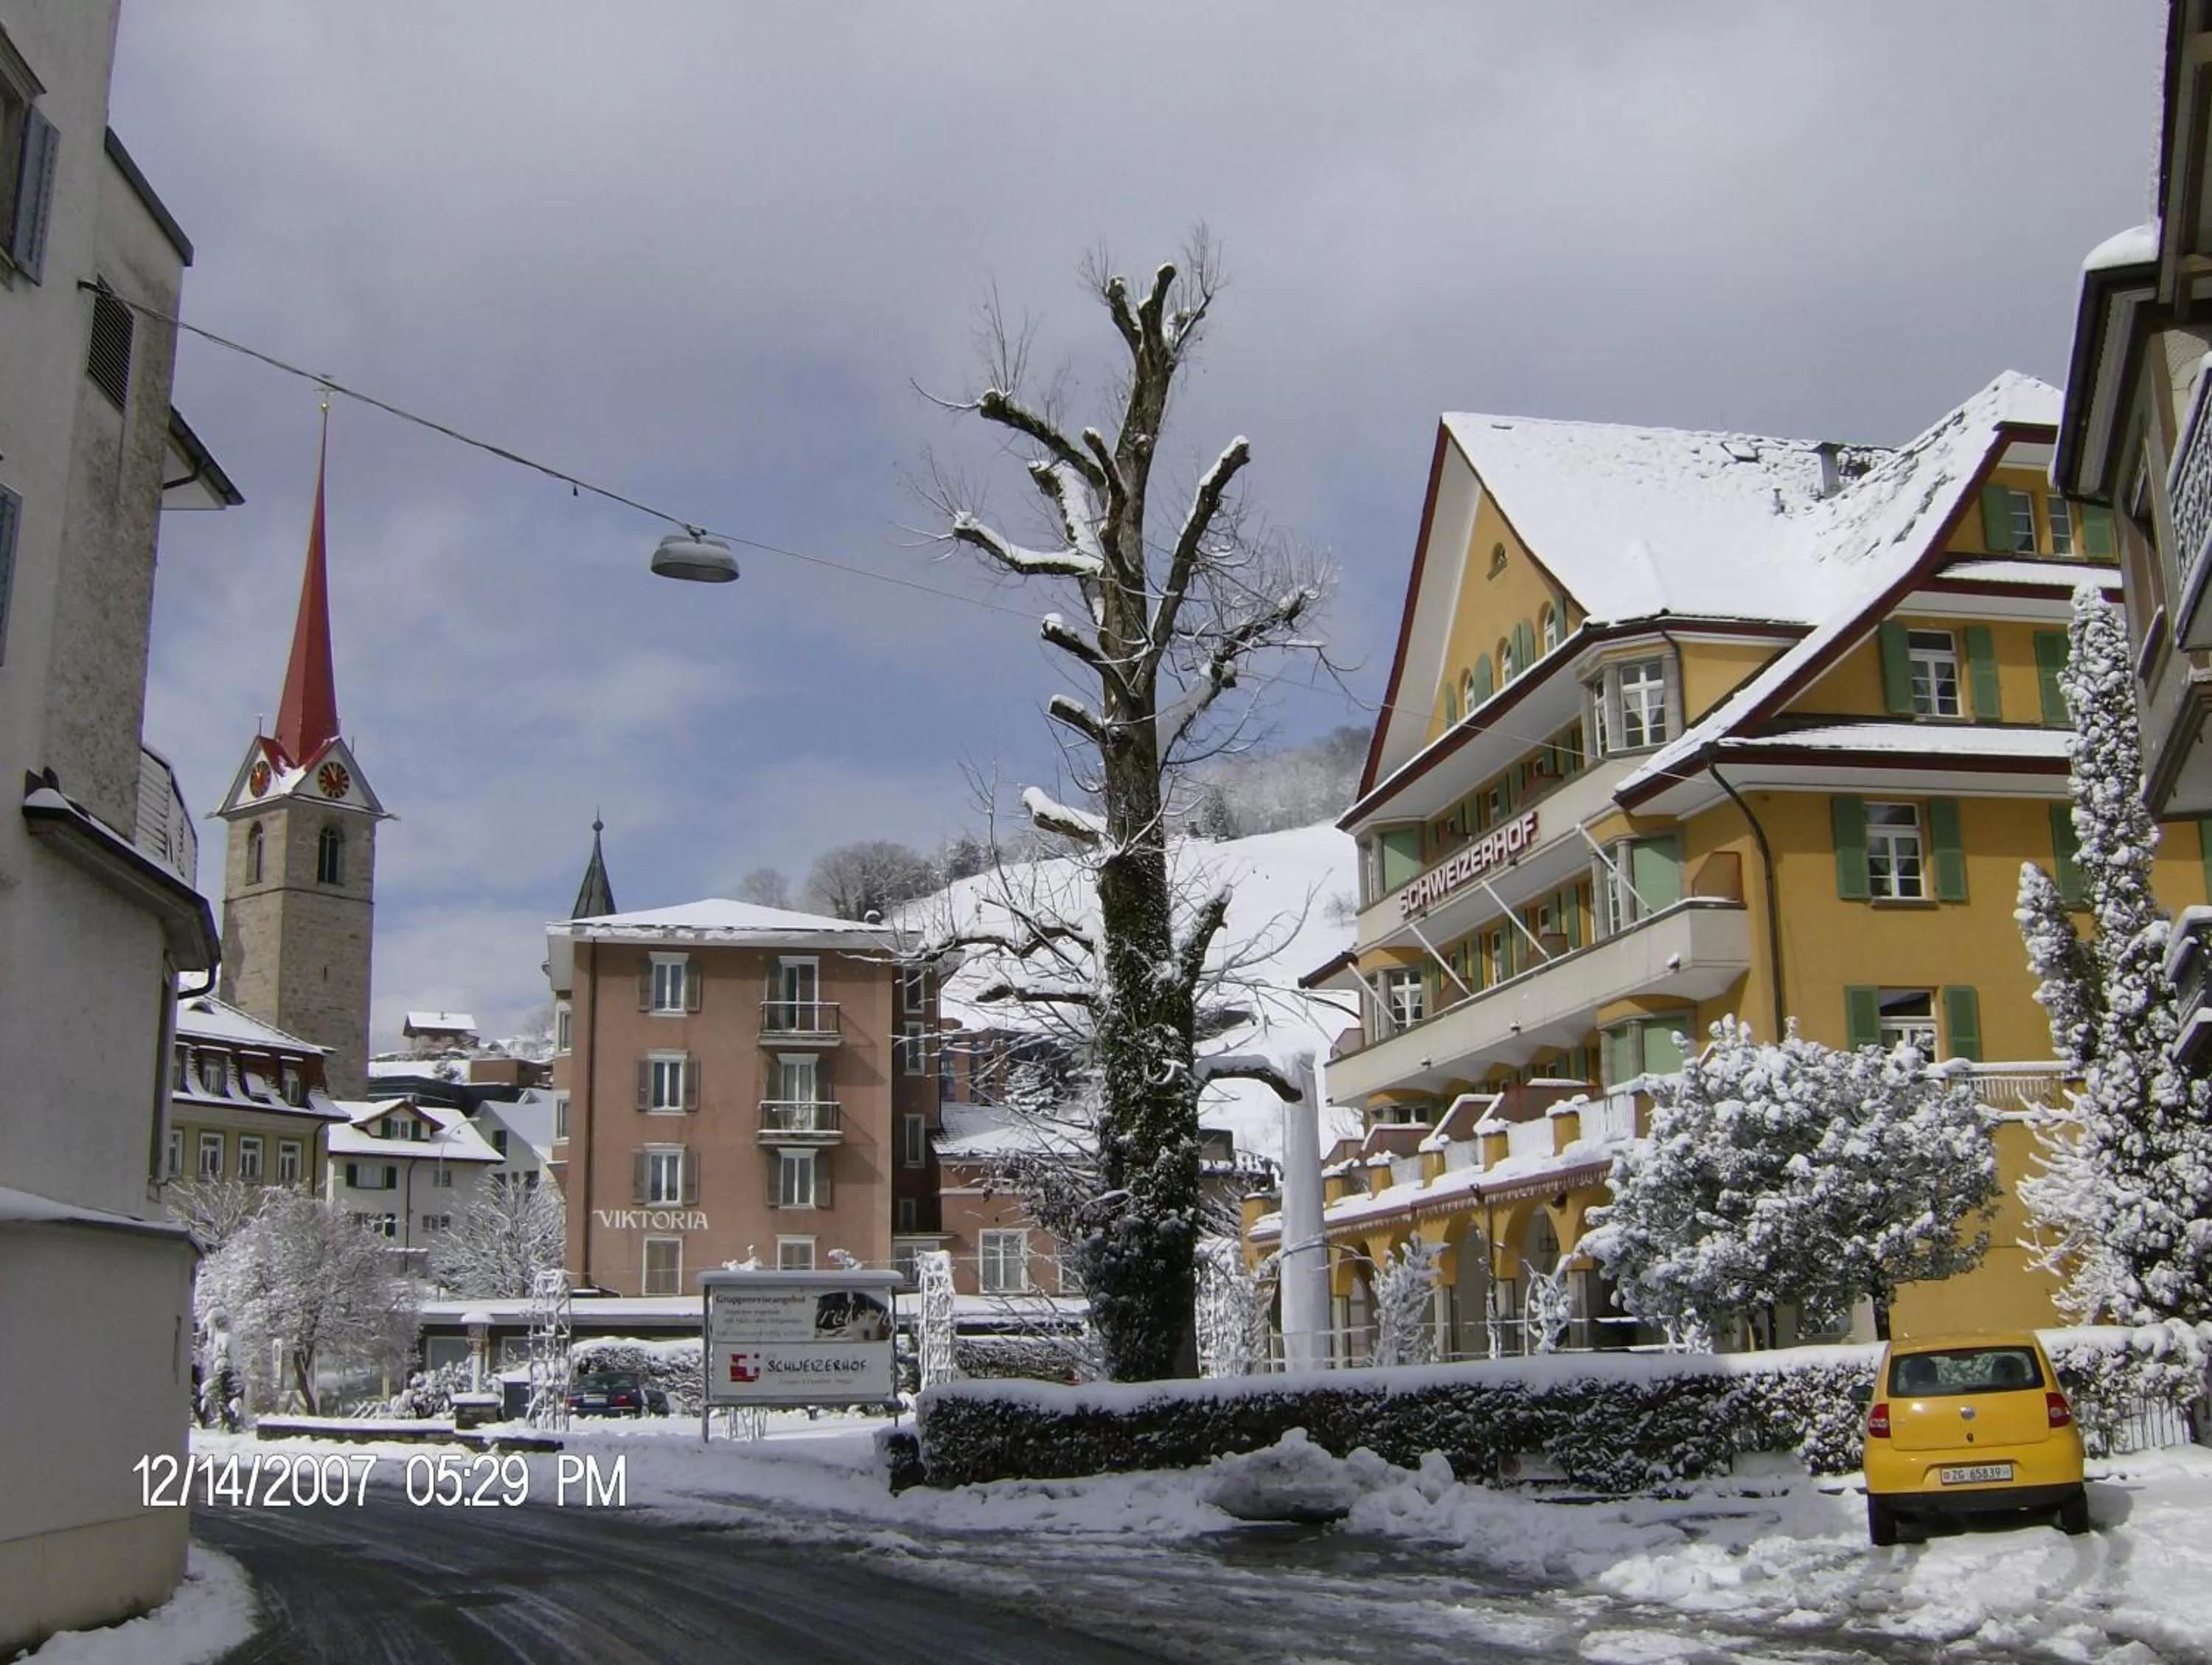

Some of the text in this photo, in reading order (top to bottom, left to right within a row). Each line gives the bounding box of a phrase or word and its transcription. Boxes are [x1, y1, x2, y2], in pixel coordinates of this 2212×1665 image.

[1400, 810, 1537, 917] SCHWEIZERHOF
[592, 1209, 709, 1230] VIKTORIA
[768, 1359, 867, 1372] SCHWEIZERHOF
